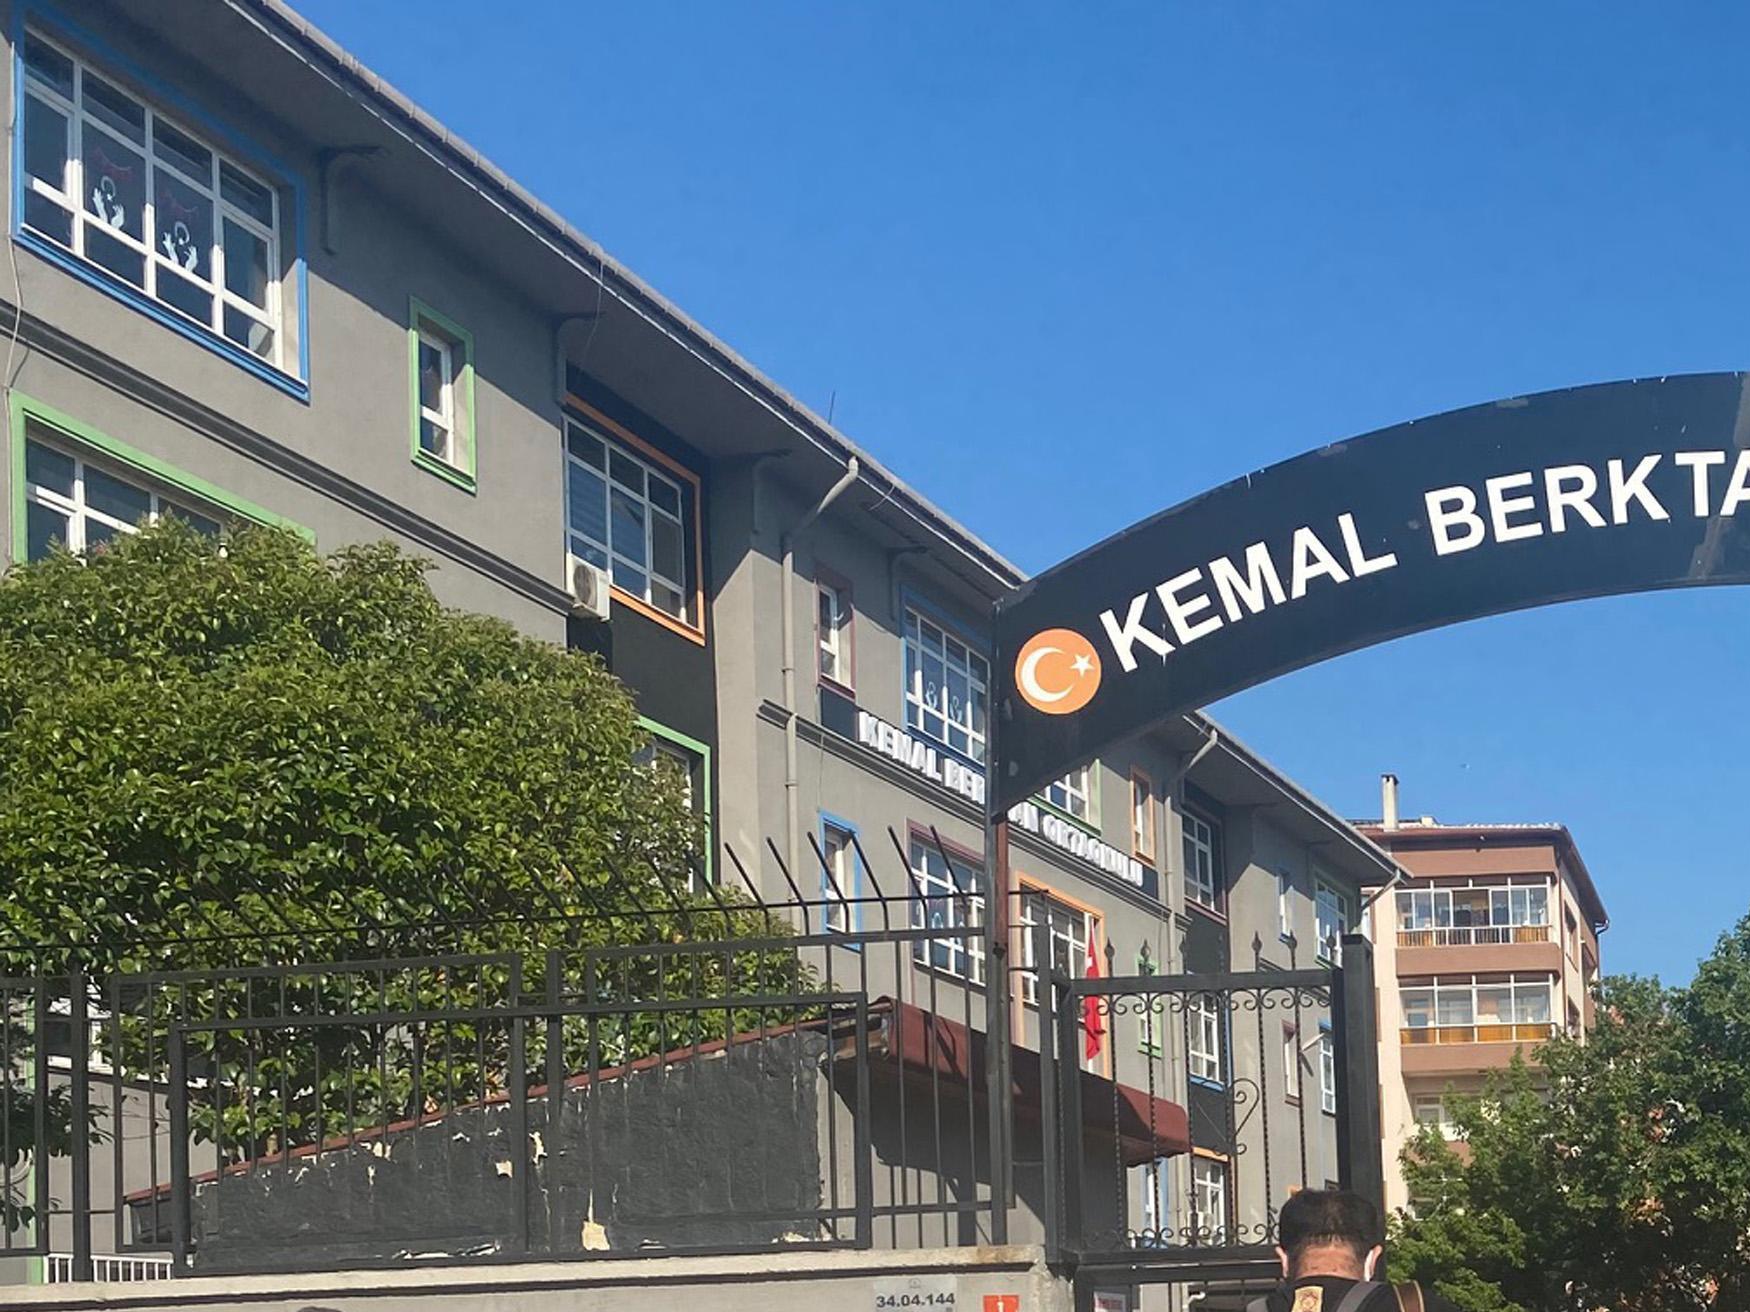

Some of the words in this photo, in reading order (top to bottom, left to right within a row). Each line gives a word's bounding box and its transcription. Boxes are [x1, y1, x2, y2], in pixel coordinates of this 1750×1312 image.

[1100, 513, 1398, 673] KEMAL
[859, 711, 942, 782] KEMAL
[876, 1293, 956, 1308] 34.04.144
